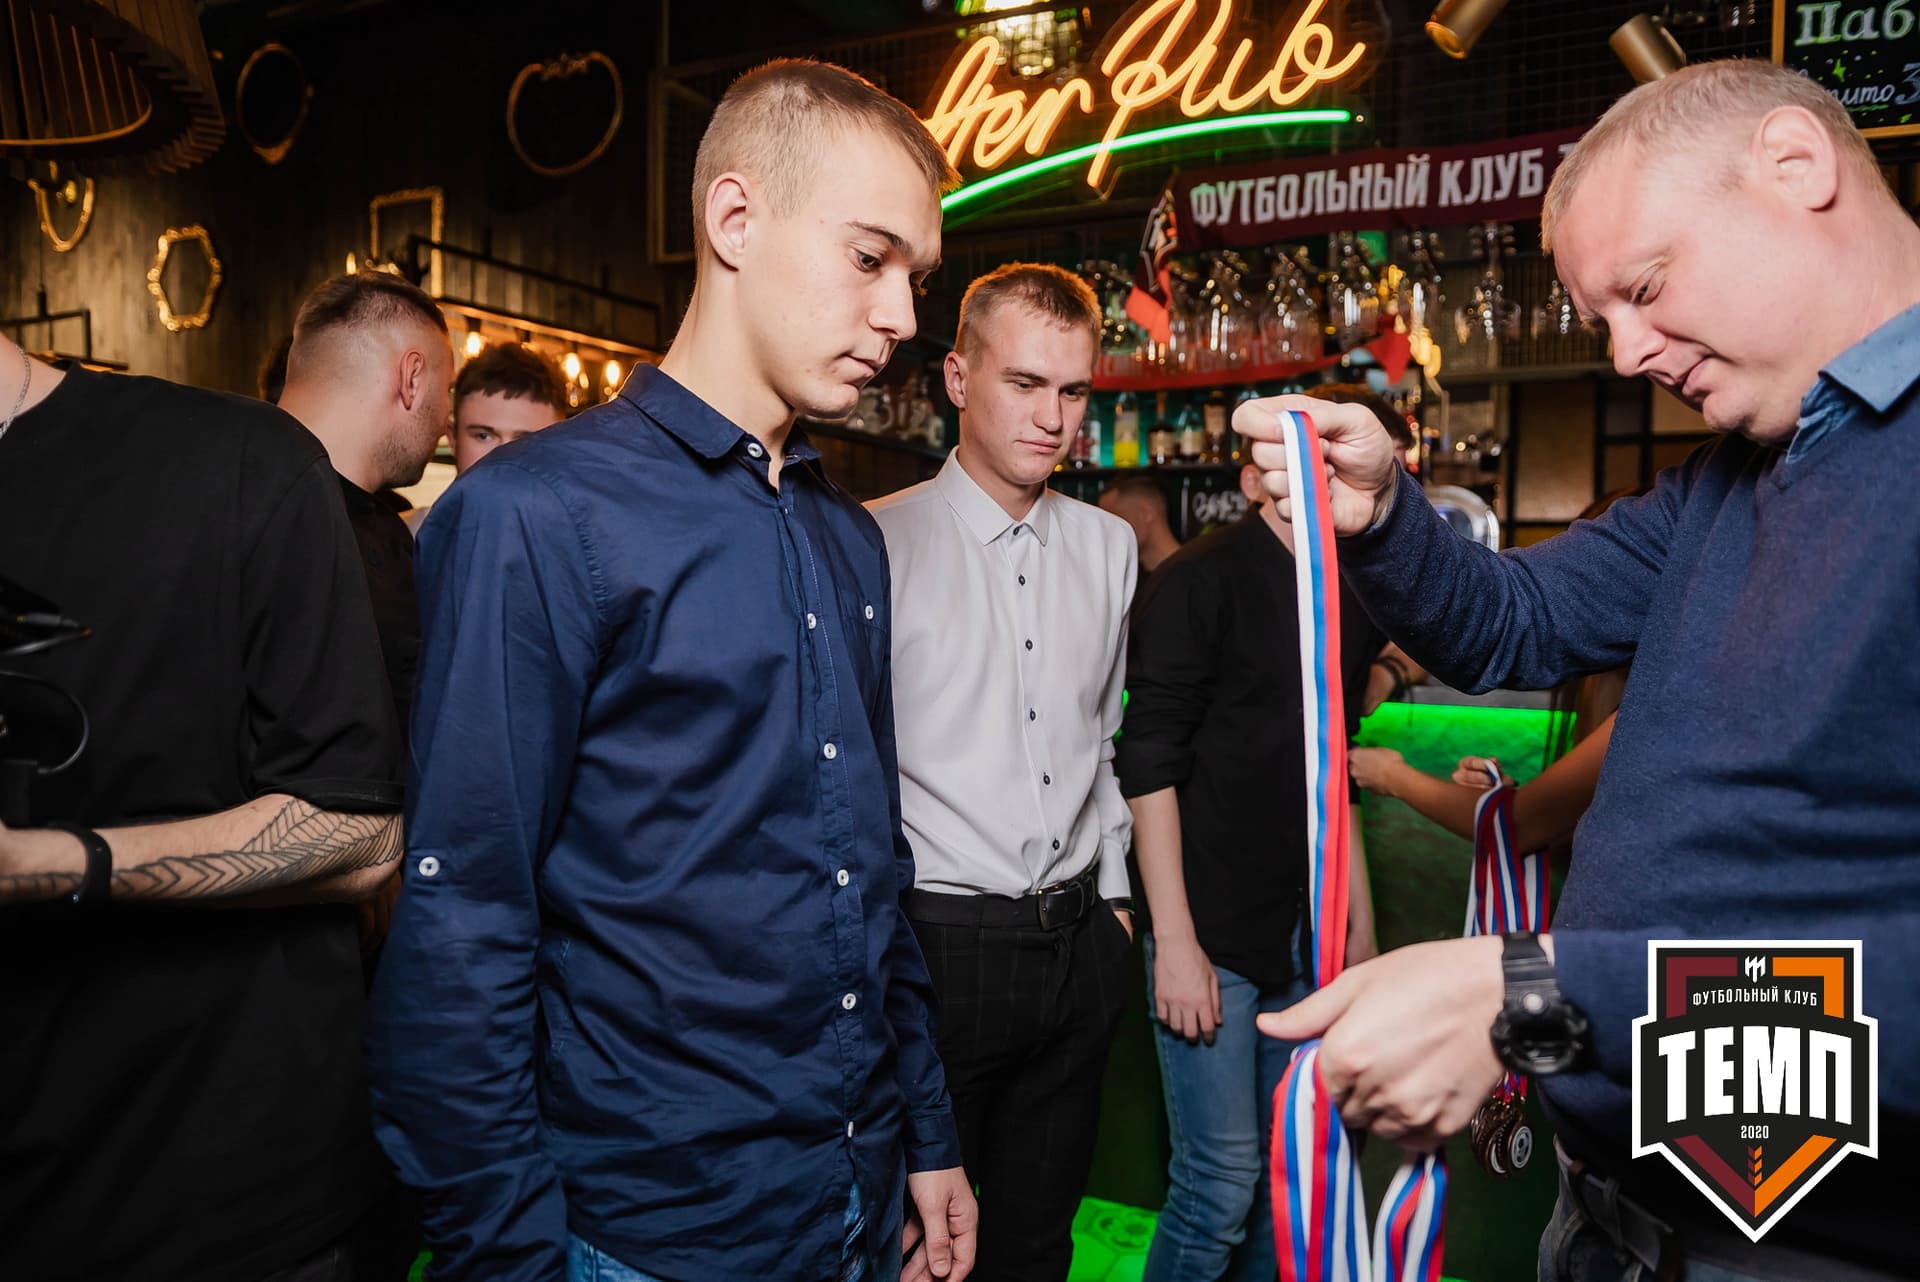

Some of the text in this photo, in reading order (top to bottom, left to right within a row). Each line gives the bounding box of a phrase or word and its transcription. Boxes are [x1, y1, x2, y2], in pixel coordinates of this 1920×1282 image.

[1794, 0, 1920, 46] Паб
[923, 0, 1366, 188] fter Pub
[1190, 149, 1544, 227] ФУТБОЛЬНЫЙ КЛУБ
